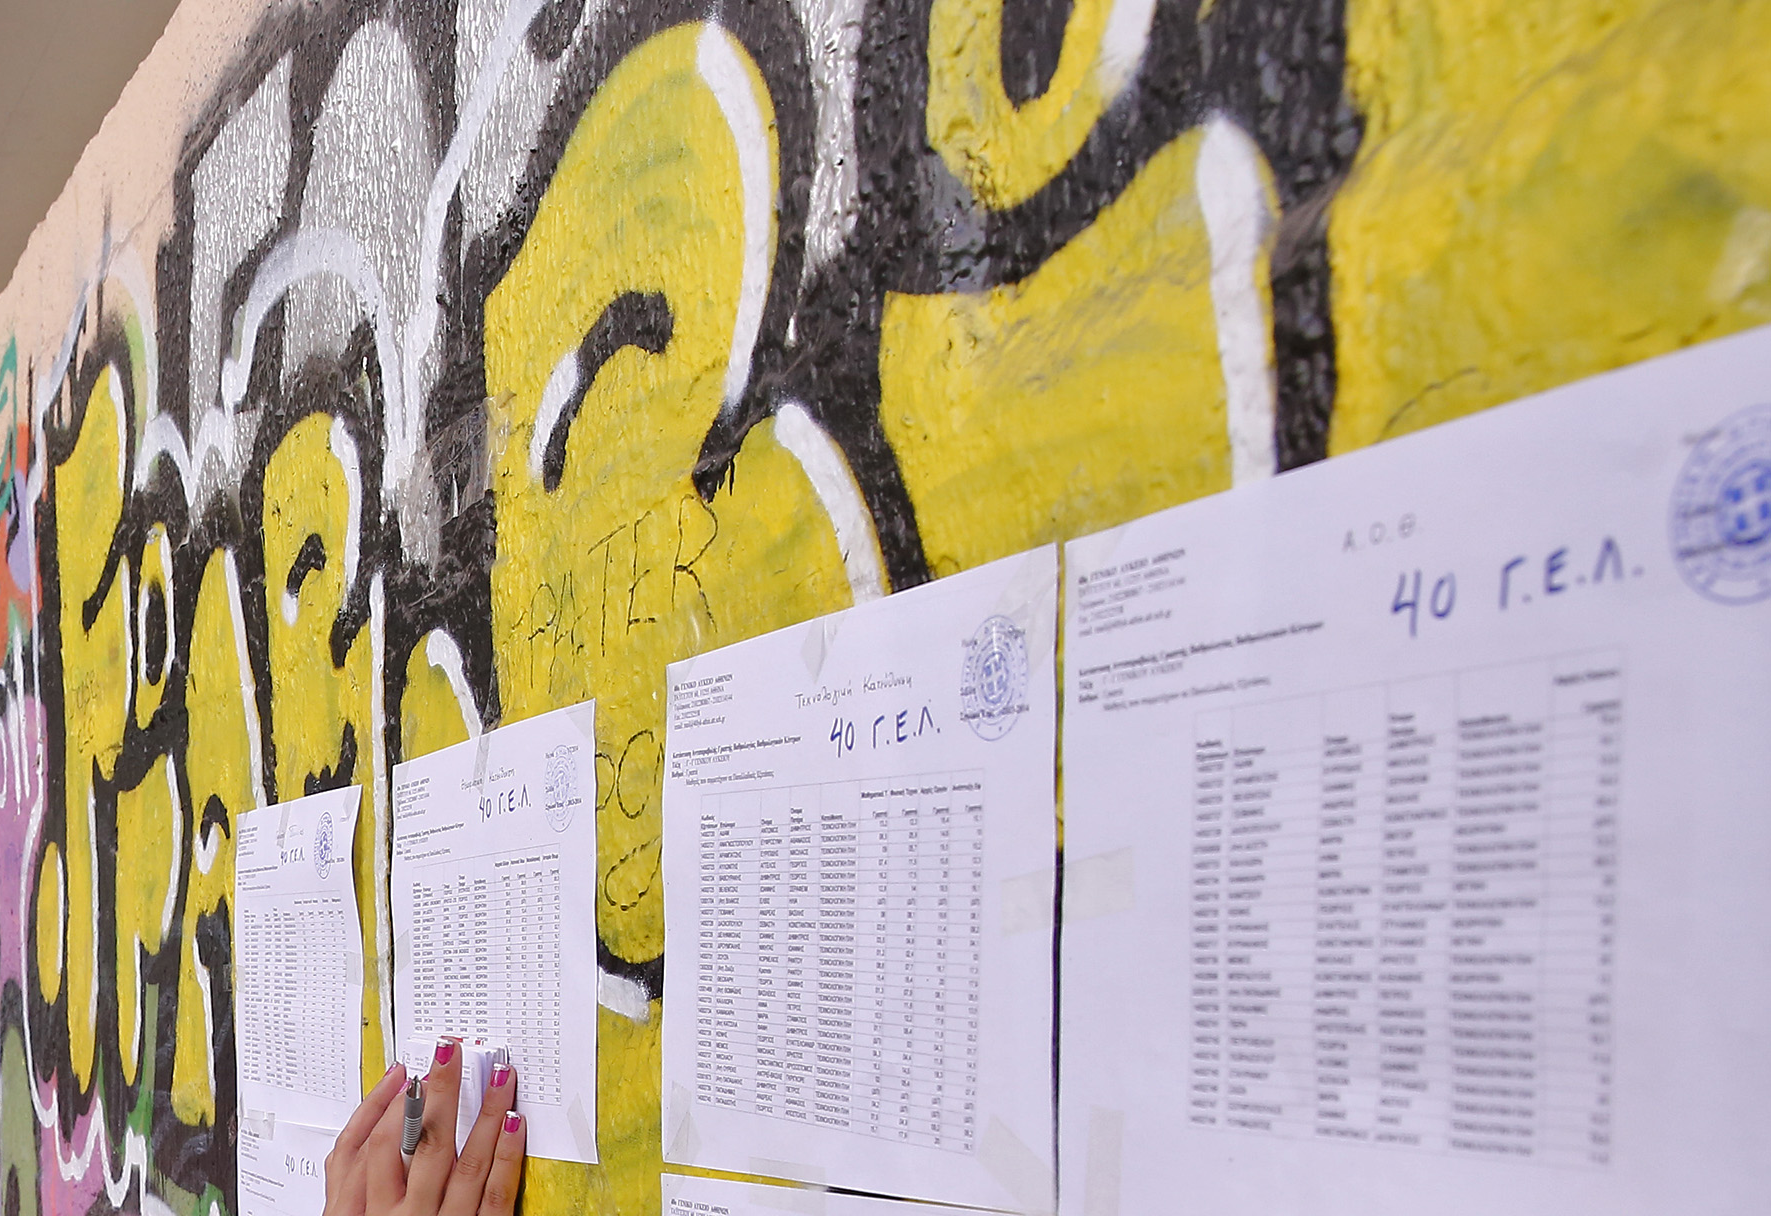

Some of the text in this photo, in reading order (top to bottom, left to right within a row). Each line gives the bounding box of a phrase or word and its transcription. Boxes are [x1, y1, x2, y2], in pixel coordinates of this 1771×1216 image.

[1391, 570, 1456, 638] 40
[829, 717, 855, 758] 40
[478, 795, 492, 823] 40
